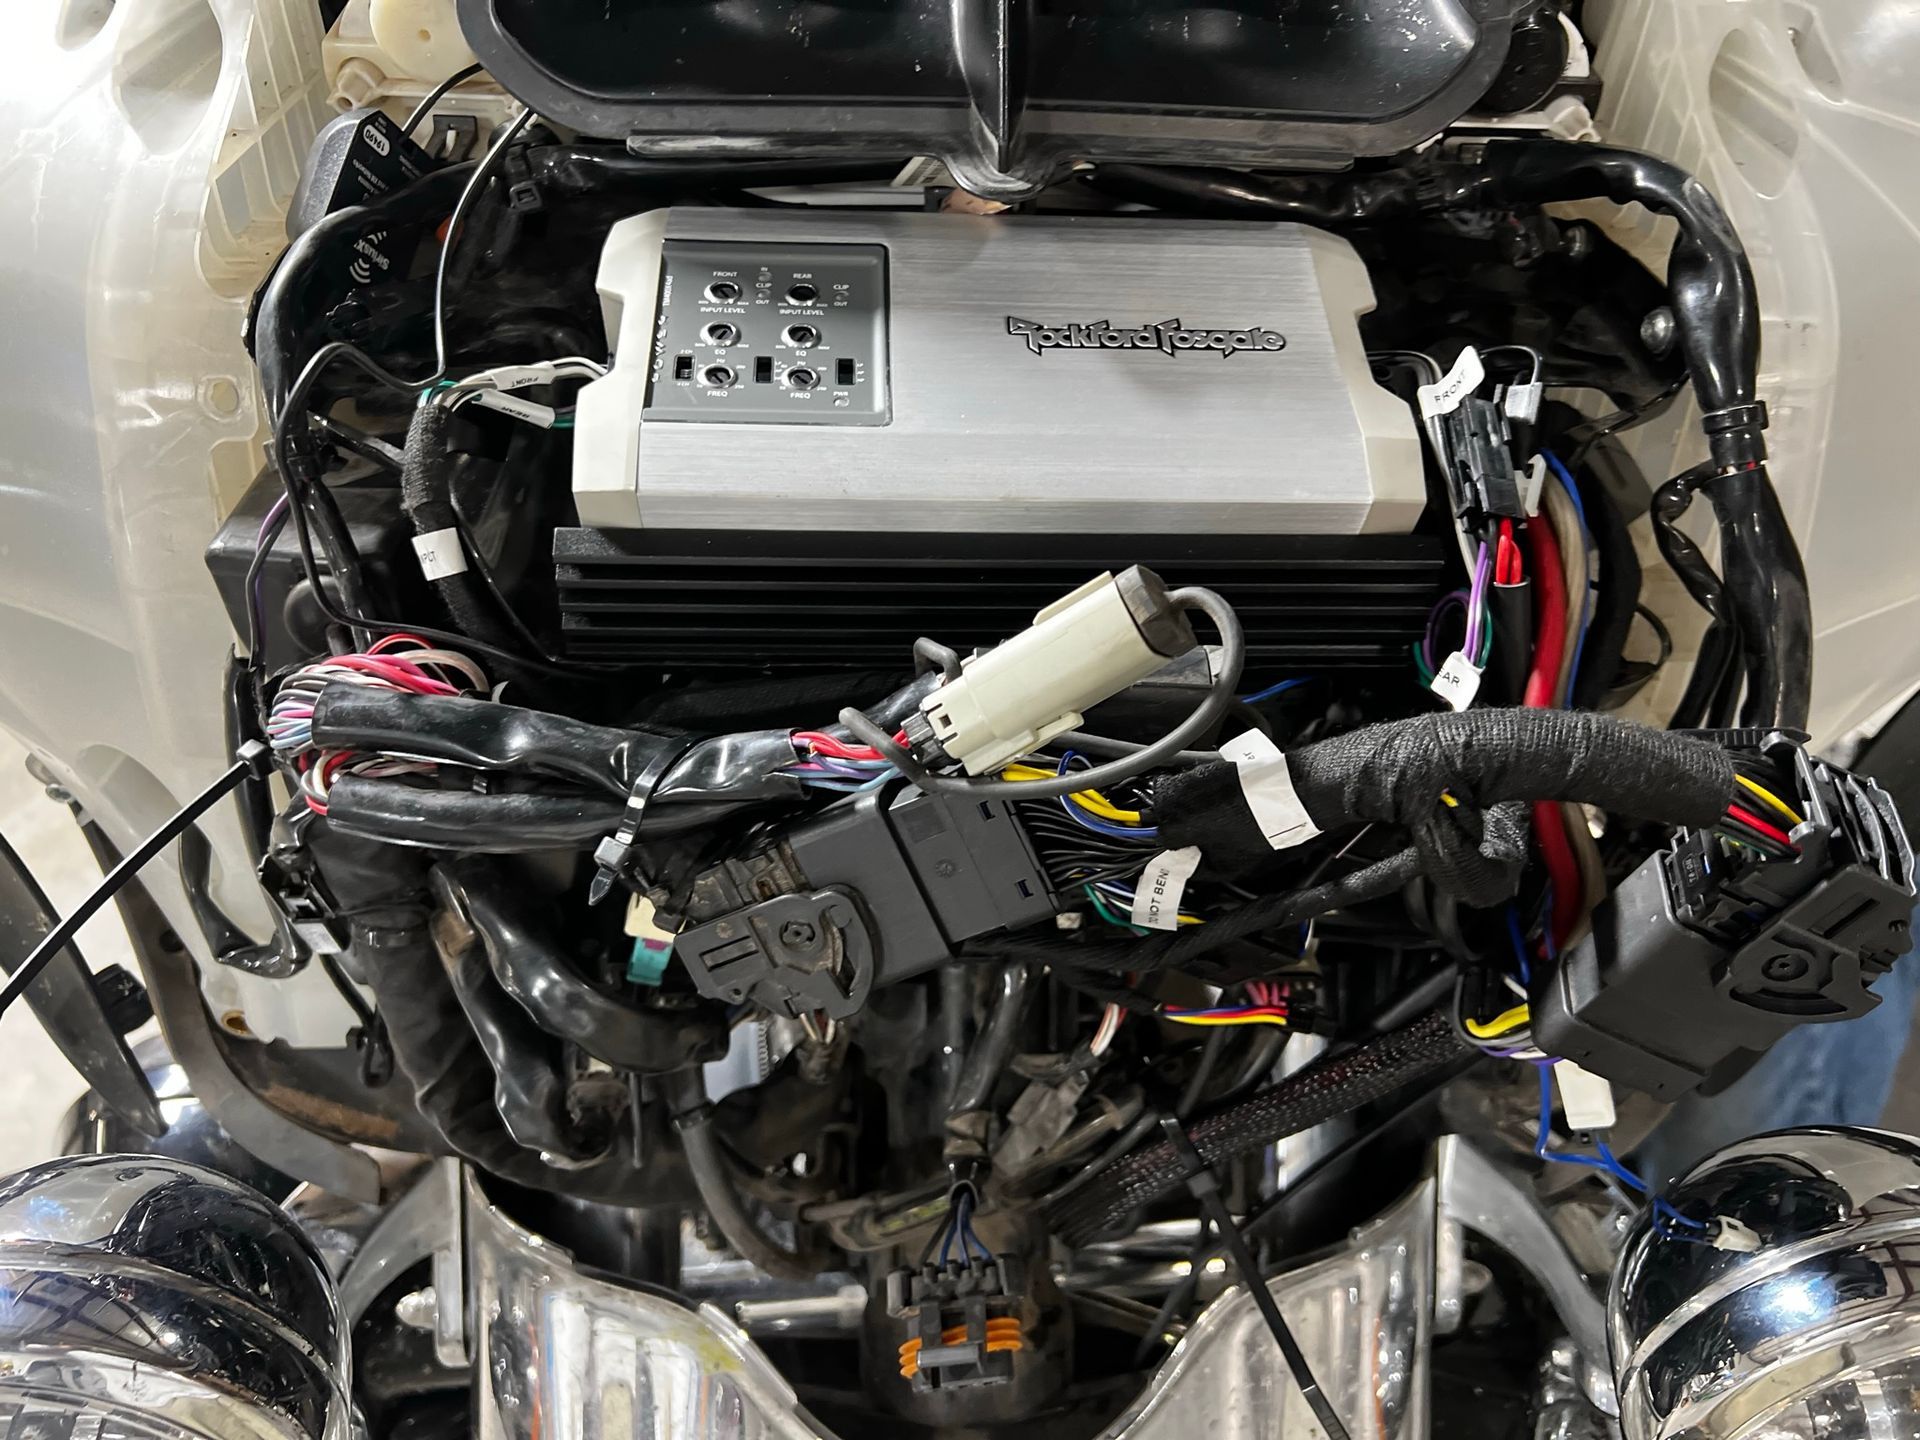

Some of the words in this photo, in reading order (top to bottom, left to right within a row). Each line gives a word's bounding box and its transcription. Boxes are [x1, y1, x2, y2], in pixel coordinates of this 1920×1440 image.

[353, 239, 390, 270] SiriusX
[1007, 316, 1158, 356] Rockford
[1153, 318, 1287, 359] Fosgate
[511, 376, 539, 388] FRONT
[501, 406, 530, 419] REAR
